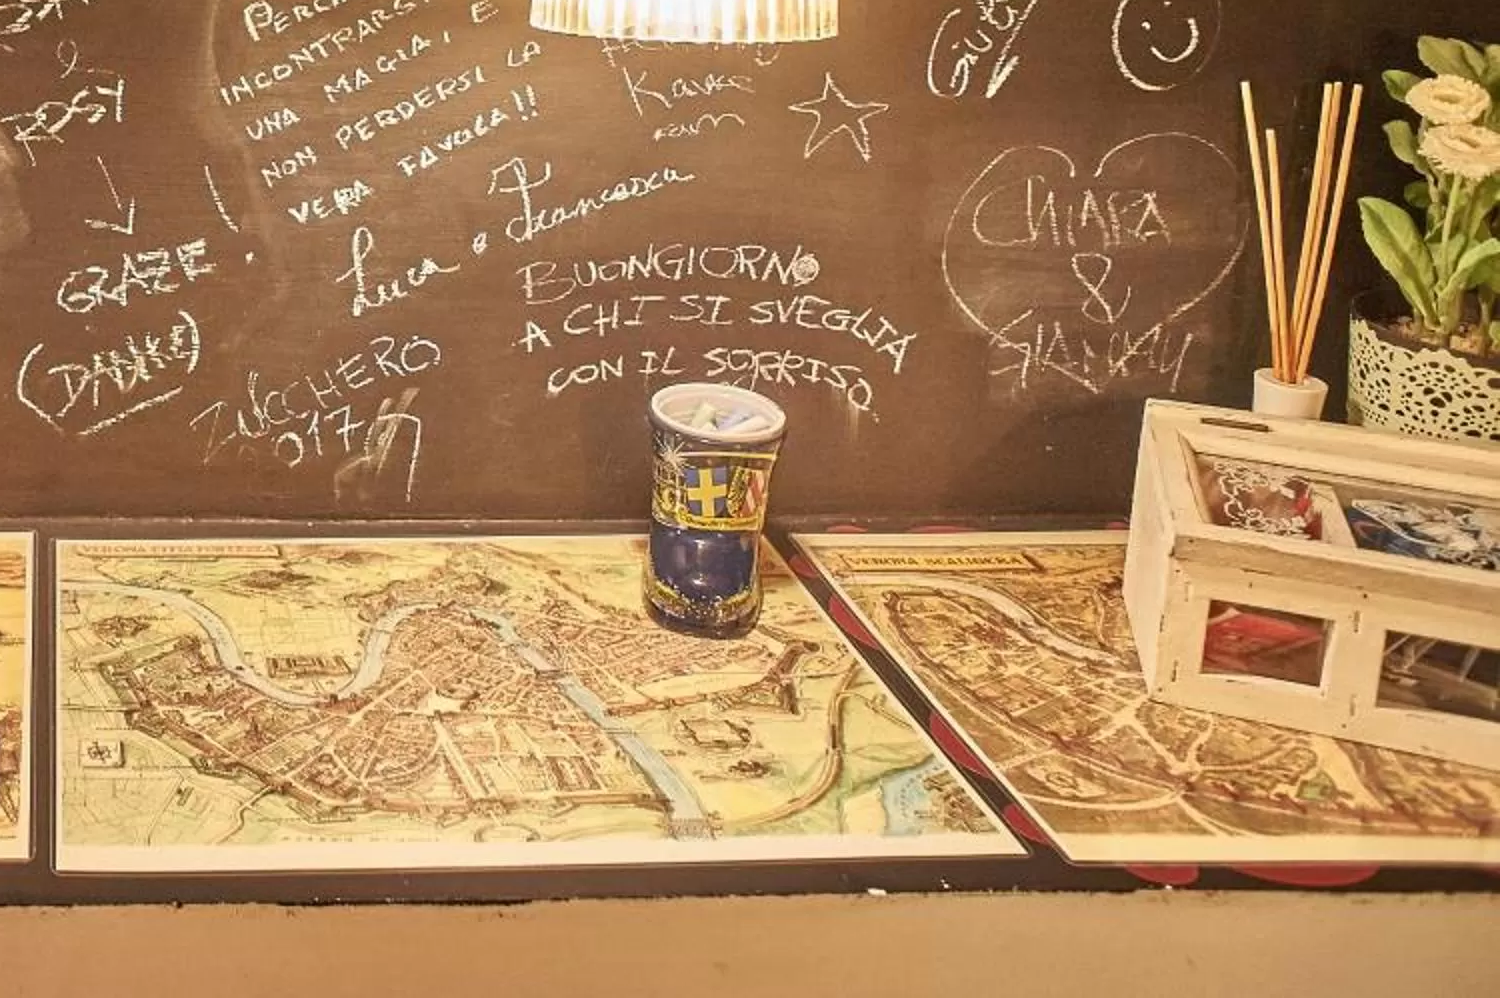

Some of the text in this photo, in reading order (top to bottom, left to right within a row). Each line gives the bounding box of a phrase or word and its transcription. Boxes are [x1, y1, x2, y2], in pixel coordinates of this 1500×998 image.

[334, 65, 487, 152] PERDERSI
[515, 242, 821, 305] BUONGIORNO
[513, 319, 552, 355] A
[562, 294, 664, 338] CHI
[544, 357, 626, 398] CON
[637, 346, 682, 377] IL
